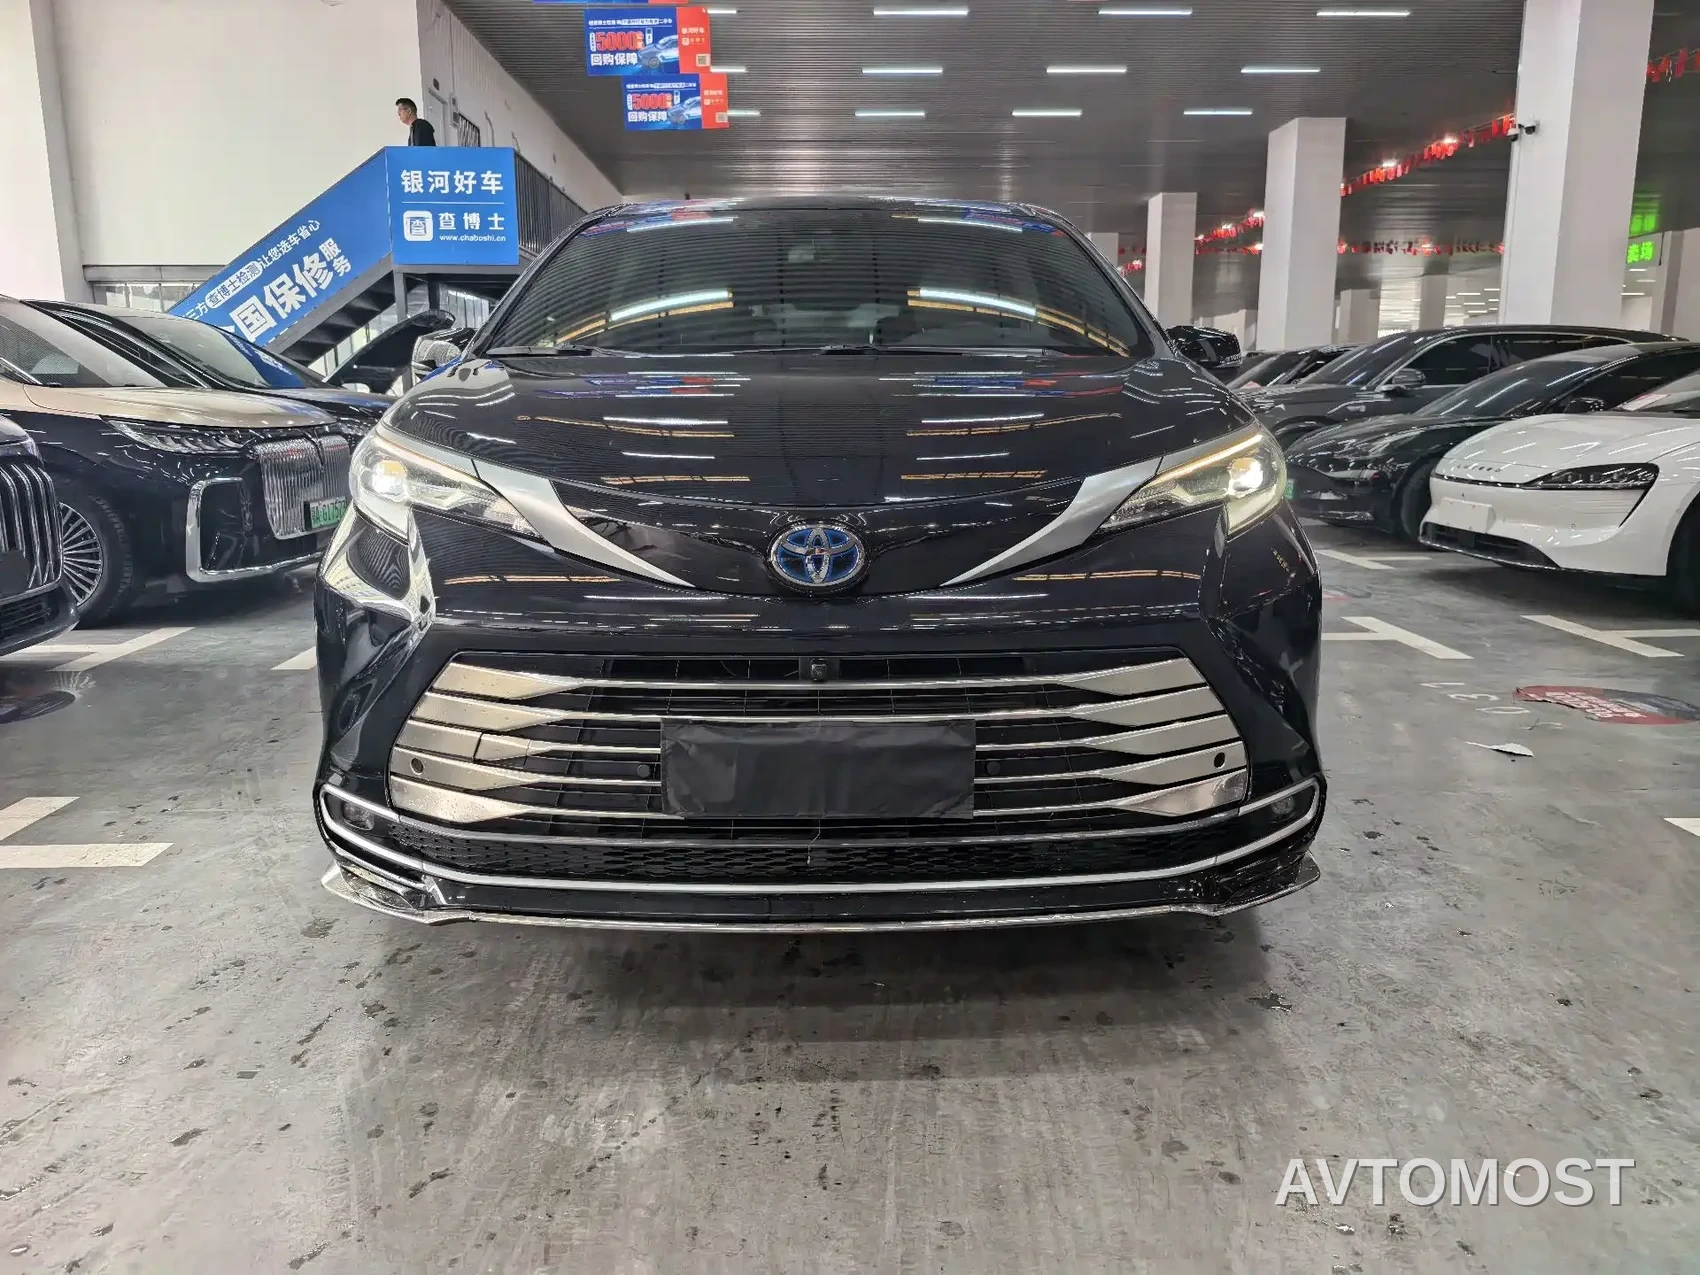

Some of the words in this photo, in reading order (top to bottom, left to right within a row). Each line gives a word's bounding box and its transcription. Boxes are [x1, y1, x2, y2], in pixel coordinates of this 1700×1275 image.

[595, 31, 638, 51] 5000
[590, 52, 639, 66] 回购保障
[632, 93, 667, 110] 5000
[627, 111, 668, 122] 回购保障
[400, 169, 504, 195] 银河好车
[438, 212, 505, 231] 查博士
[439, 234, 506, 242] www.chaboshi.cn
[183, 219, 321, 320] 三方查博士检测让您选车省心
